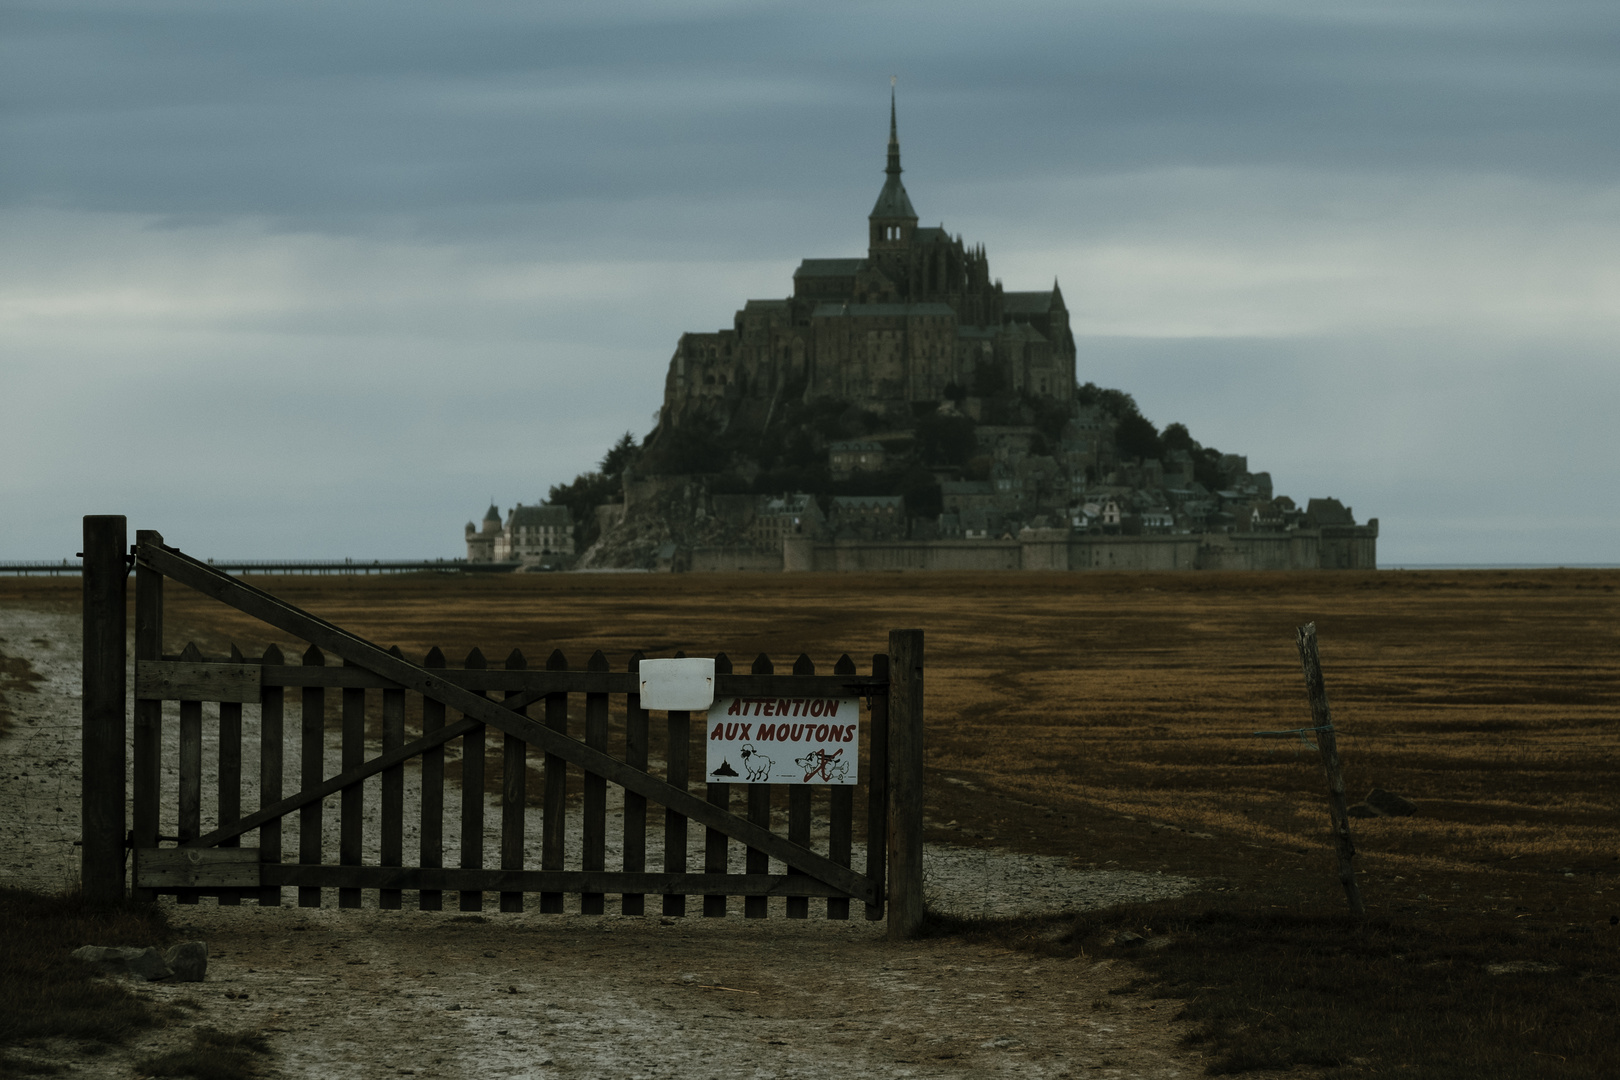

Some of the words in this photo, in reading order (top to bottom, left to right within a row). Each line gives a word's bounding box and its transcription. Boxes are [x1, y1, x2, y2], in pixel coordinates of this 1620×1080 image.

[728, 698, 840, 717] ATTENTION
[710, 722, 752, 741] AUX
[756, 723, 857, 742] MOUTONS
